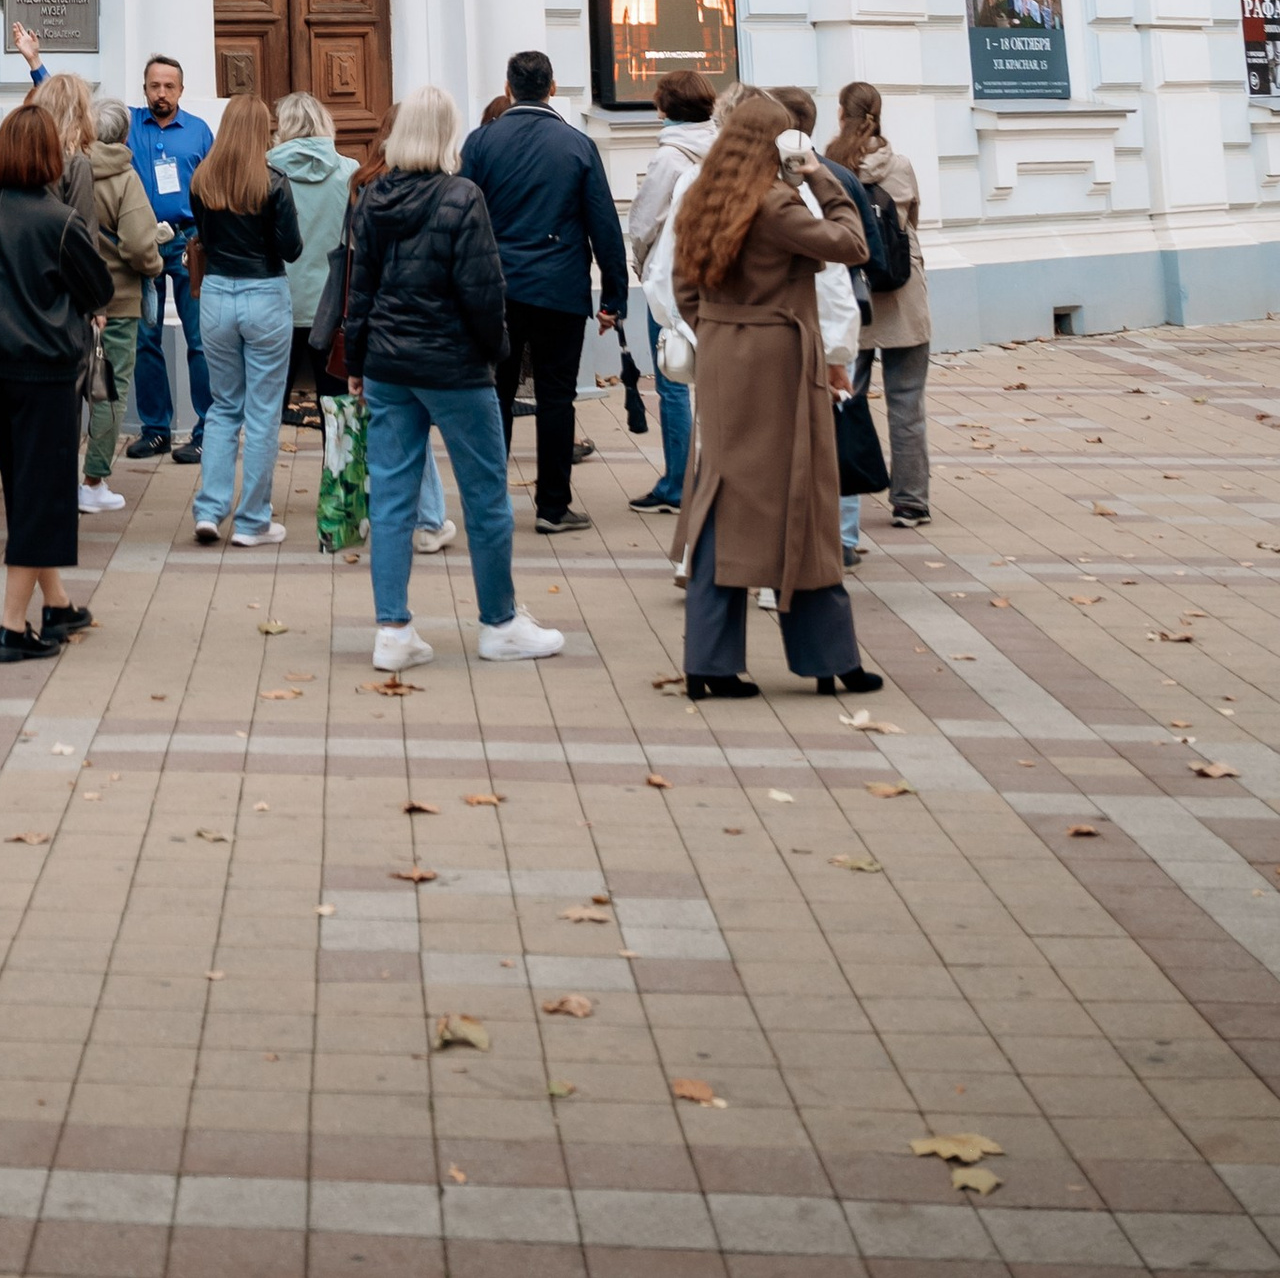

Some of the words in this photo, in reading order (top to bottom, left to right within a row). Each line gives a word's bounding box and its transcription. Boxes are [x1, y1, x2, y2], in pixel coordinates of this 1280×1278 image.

[40, 5, 67, 16] МУЗЕЙ
[986, 38, 991, 50] 1
[1000, 38, 1010, 50] 18
[1010, 37, 1051, 51] ОКТЯБРЯ
